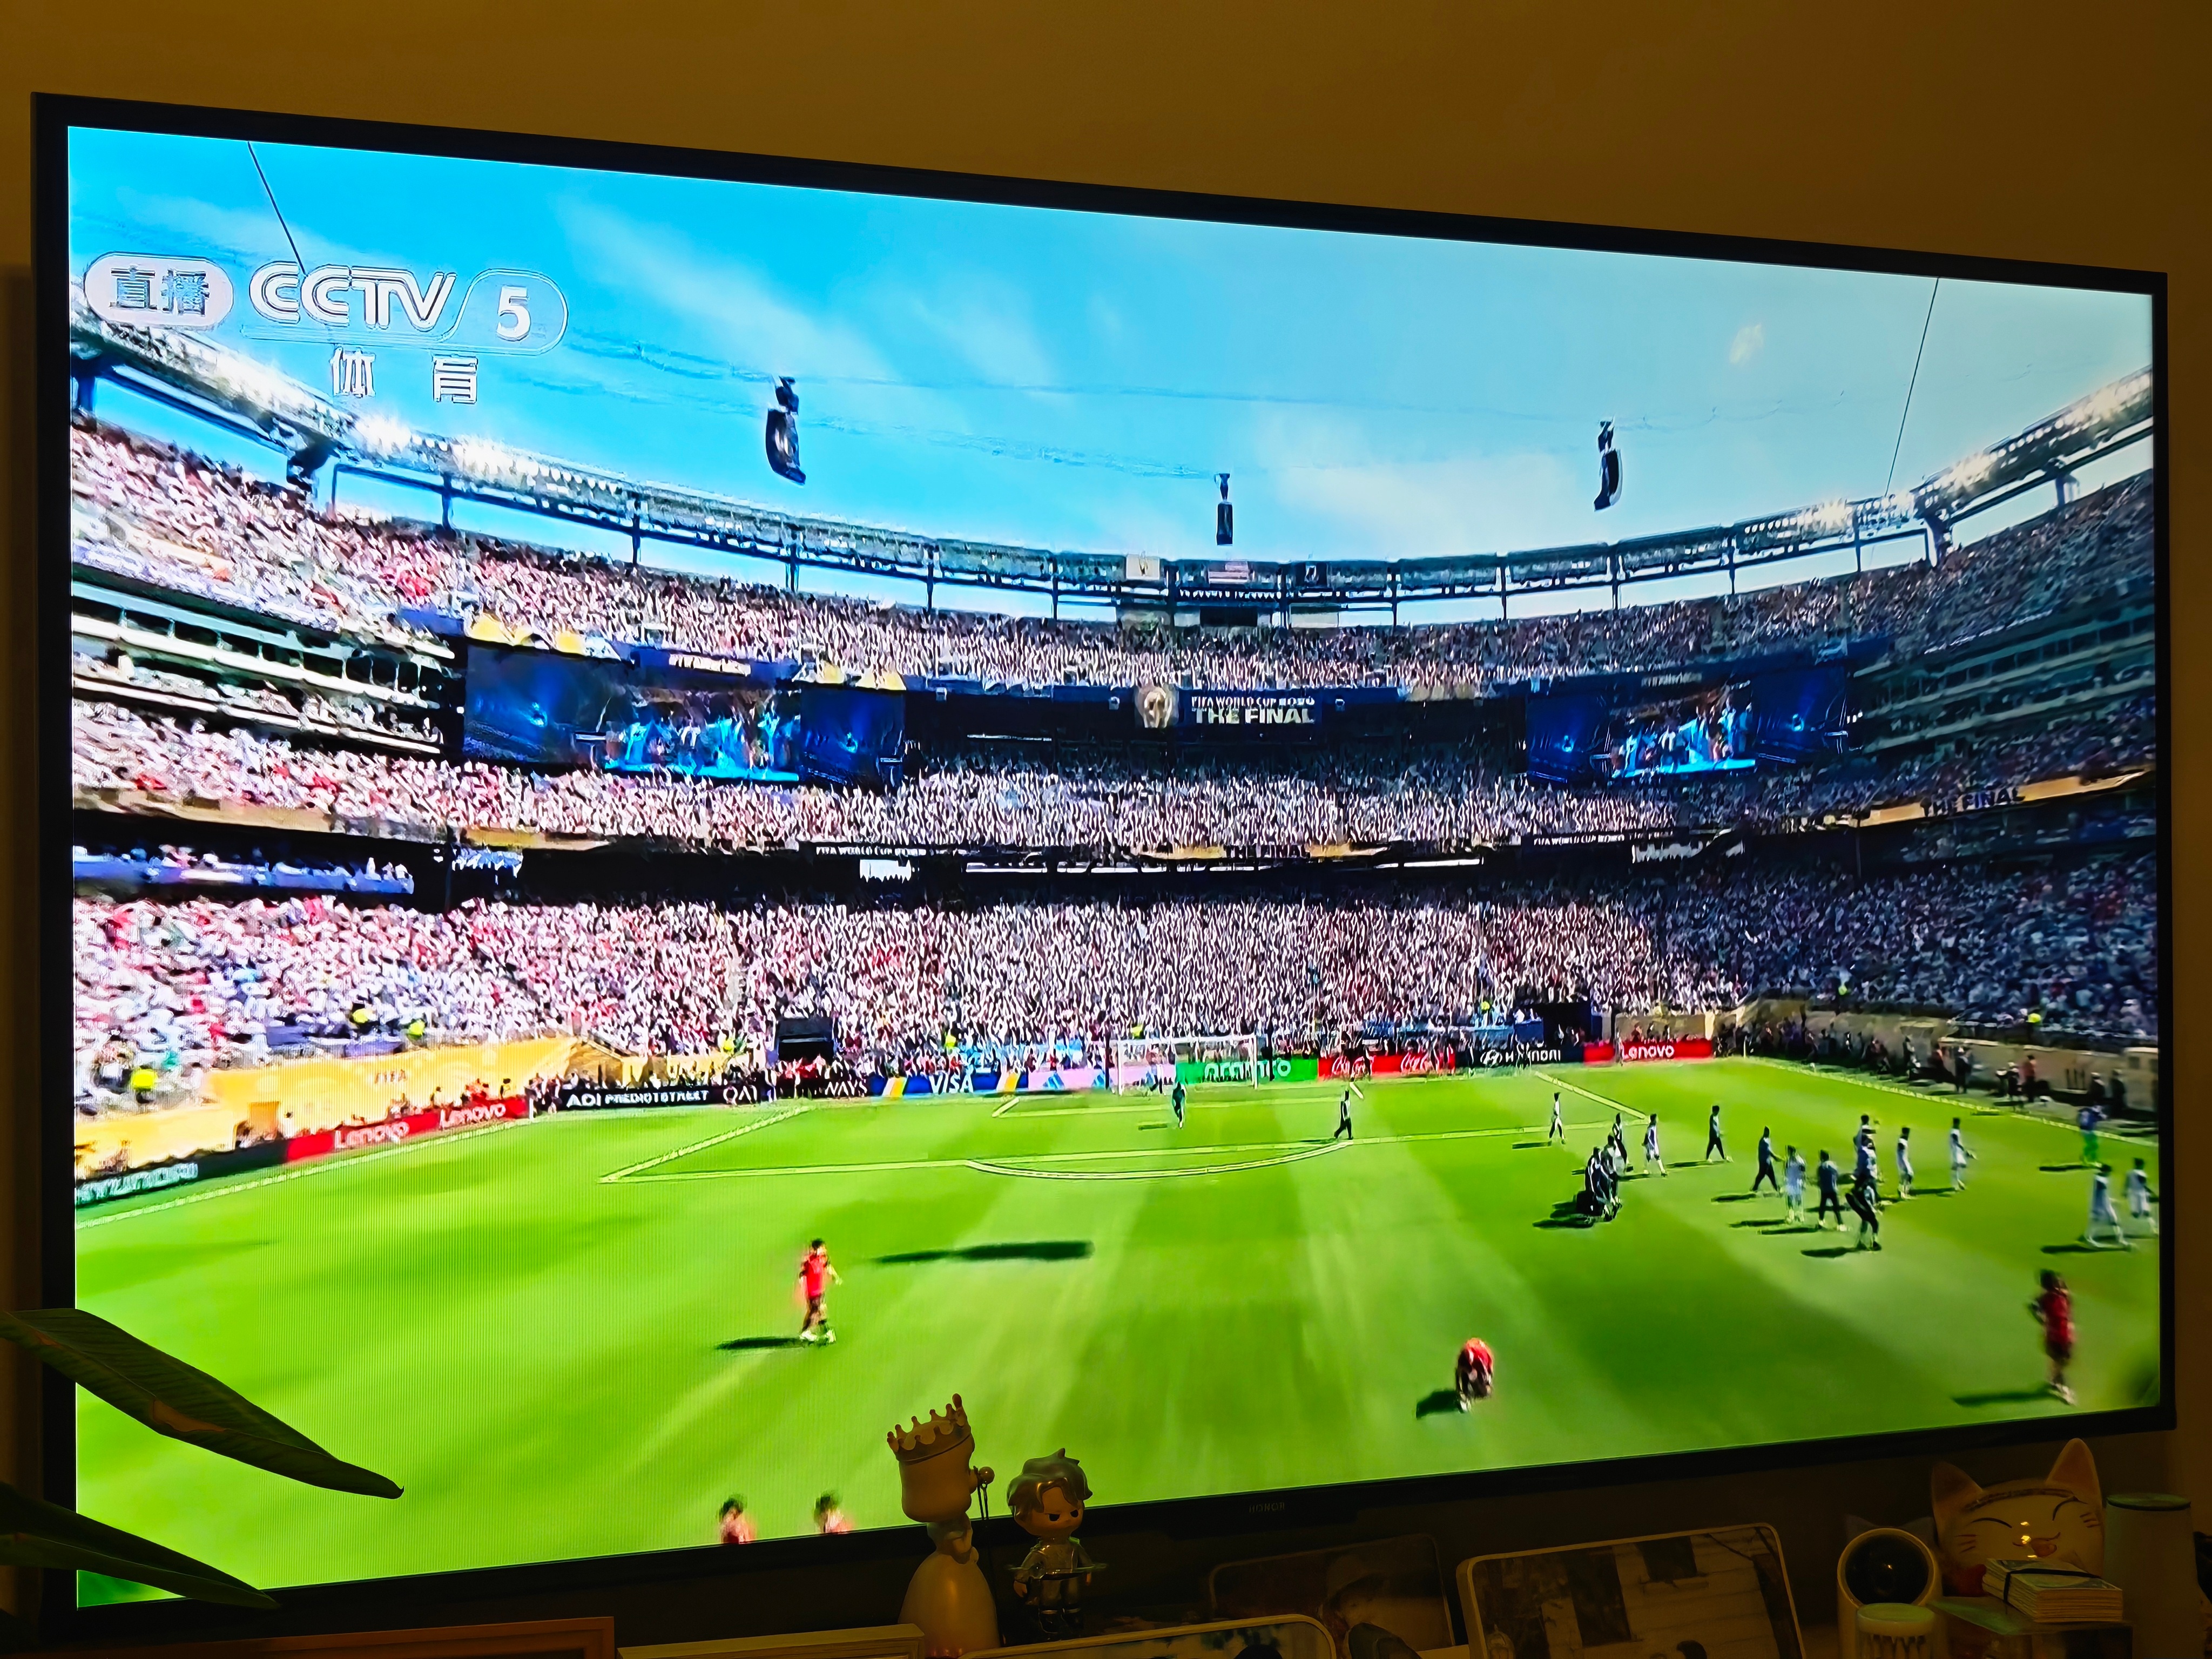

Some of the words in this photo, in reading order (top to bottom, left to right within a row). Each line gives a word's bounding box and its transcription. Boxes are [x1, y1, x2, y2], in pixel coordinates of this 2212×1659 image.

[110, 265, 210, 316] 直播
[248, 260, 456, 332] CCTV
[496, 285, 531, 341] 5
[330, 345, 478, 404] 体育
[1191, 707, 1240, 724] THE
[1245, 707, 1315, 724] FINAL
[1621, 1043, 1675, 1061] Lenovo
[928, 1073, 974, 1095] VISA
